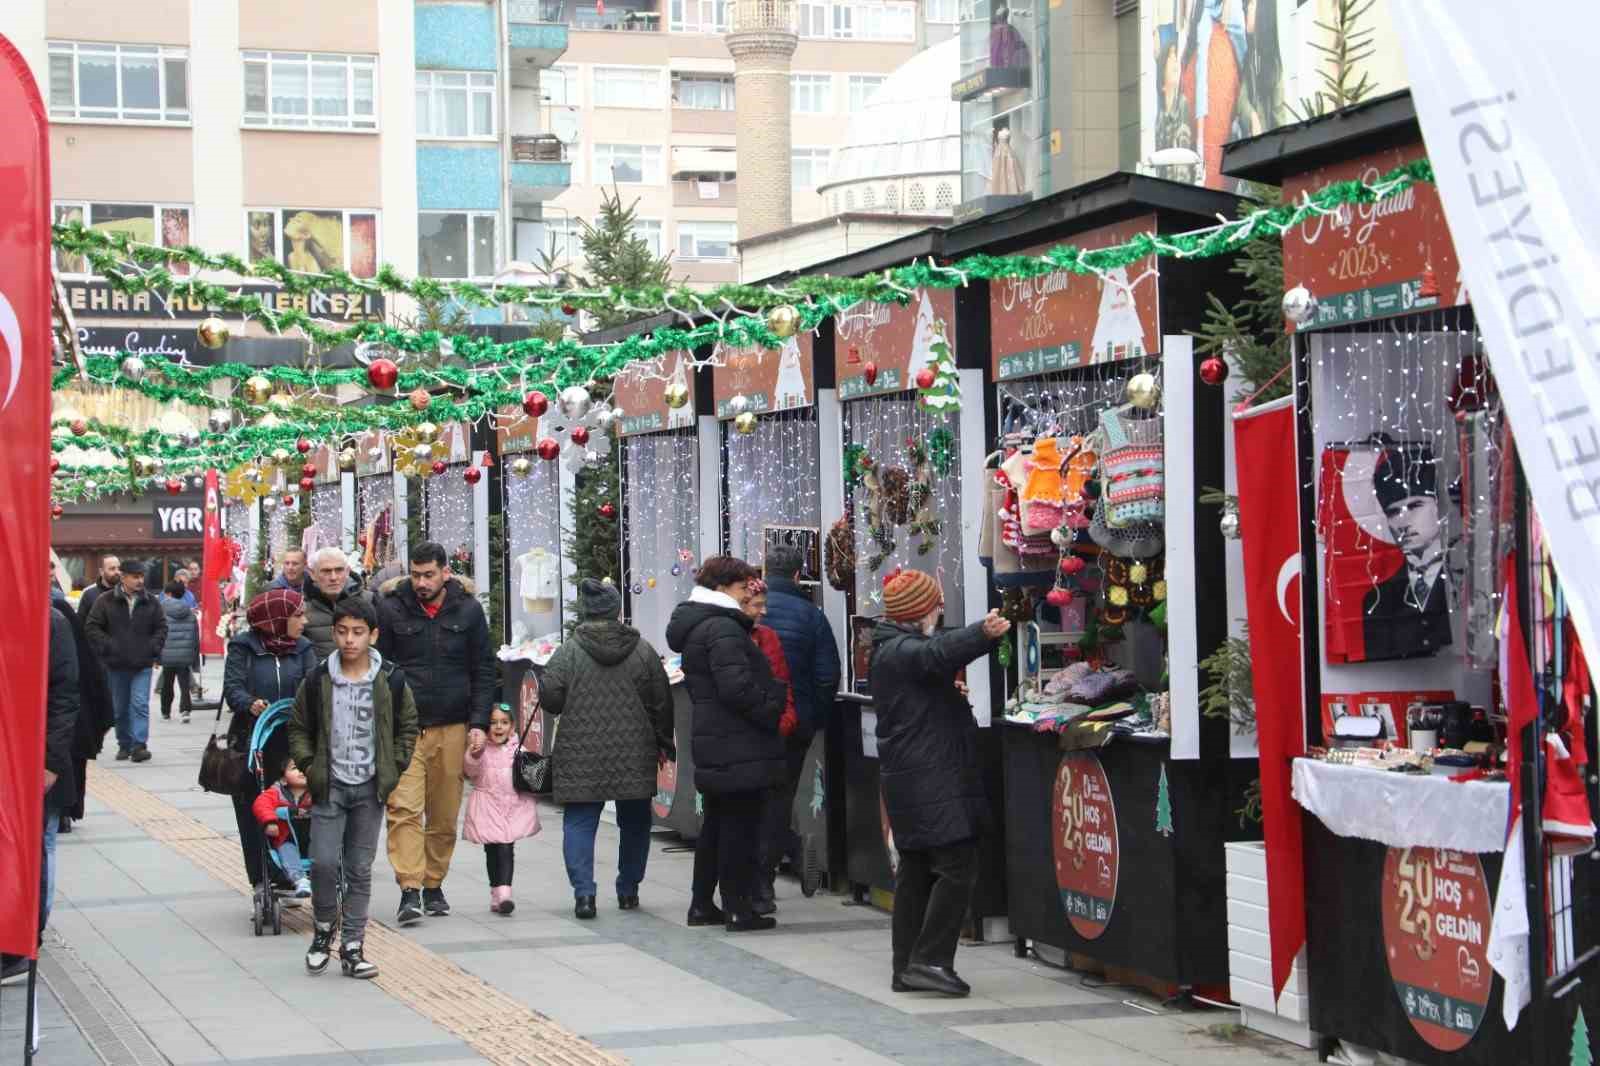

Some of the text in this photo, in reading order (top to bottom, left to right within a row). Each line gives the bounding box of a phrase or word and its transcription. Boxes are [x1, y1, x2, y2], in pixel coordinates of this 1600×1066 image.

[1338, 243, 1379, 281] 2023
[1084, 805, 1100, 828] HOŞ
[1434, 878, 1462, 911] HOŞ
[1435, 912, 1482, 945] GELDİN
